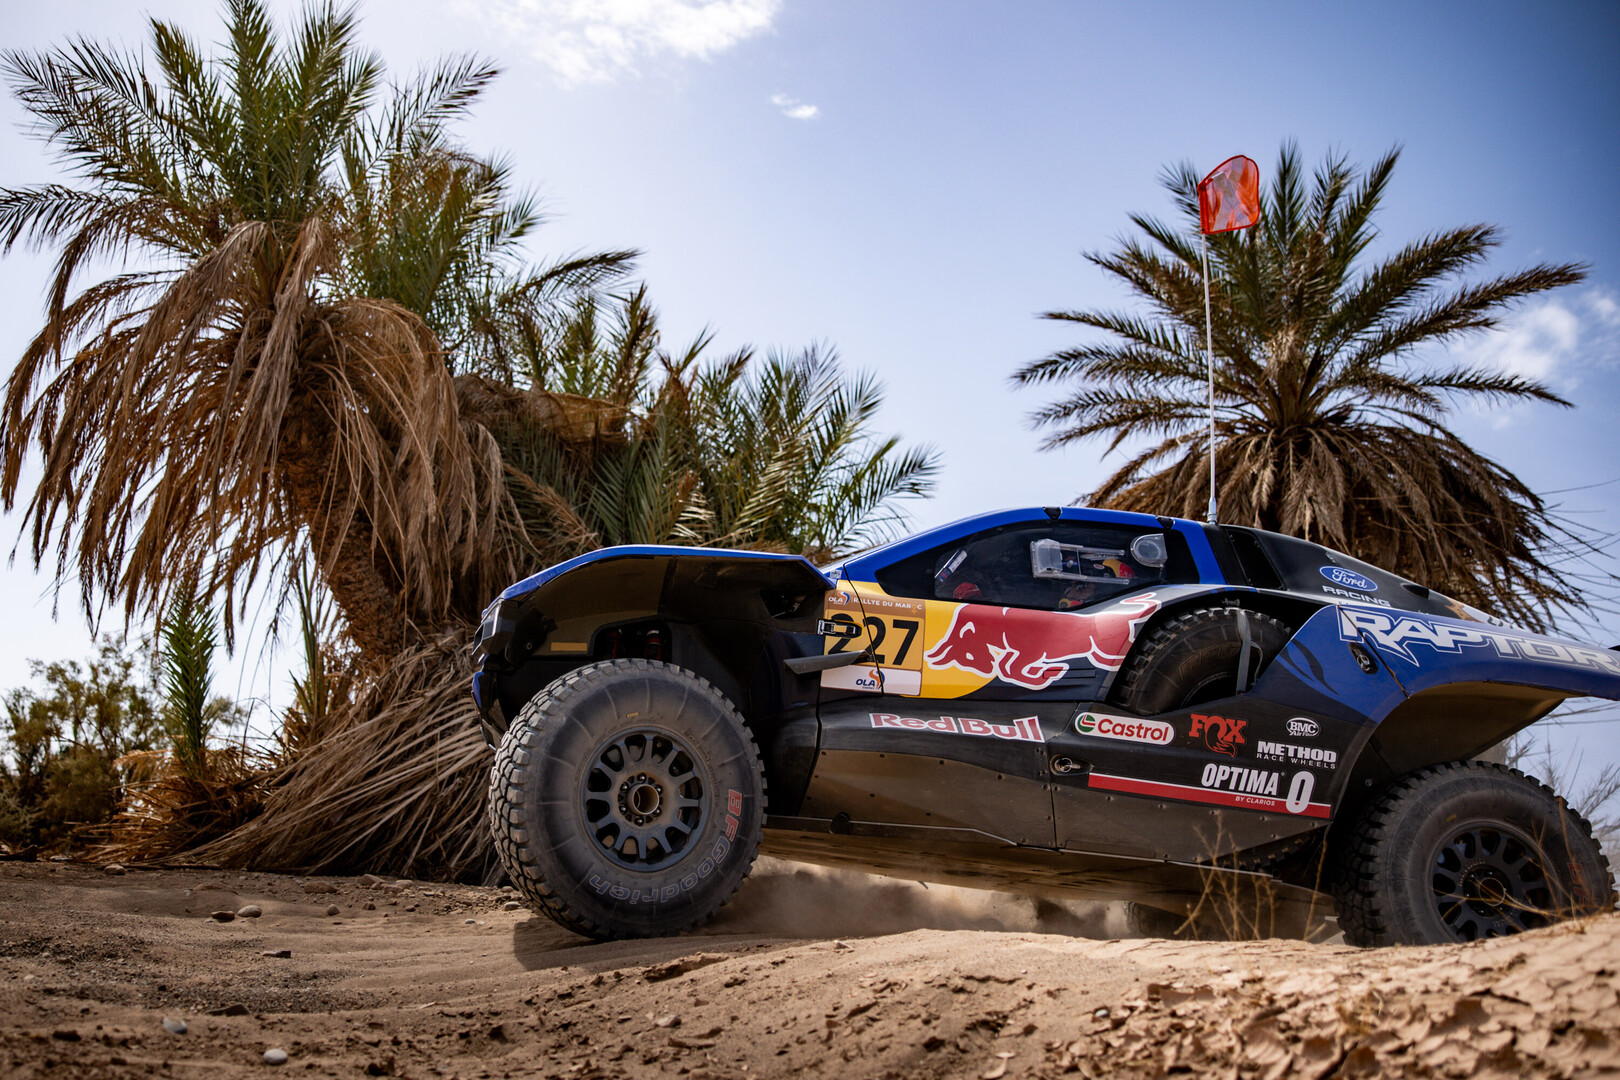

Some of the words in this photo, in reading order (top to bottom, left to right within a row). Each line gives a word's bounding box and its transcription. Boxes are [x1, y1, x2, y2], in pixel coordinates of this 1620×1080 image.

[1332, 568, 1367, 589] Ford
[1322, 585, 1391, 607] RACING
[1336, 605, 1620, 675] RAPTOR
[856, 678, 875, 687] OLA
[869, 713, 958, 733] Red
[958, 716, 1045, 743] Bull
[1097, 718, 1169, 742] Castrol
[1189, 713, 1247, 757] FOX
[1290, 721, 1316, 734] BMC
[1256, 753, 1285, 763] RACE
[1291, 757, 1336, 770] WHEELS
[1257, 740, 1337, 763] METHOD
[1201, 763, 1280, 796] OPTIMA
[1246, 797, 1275, 806] CLARIOS
